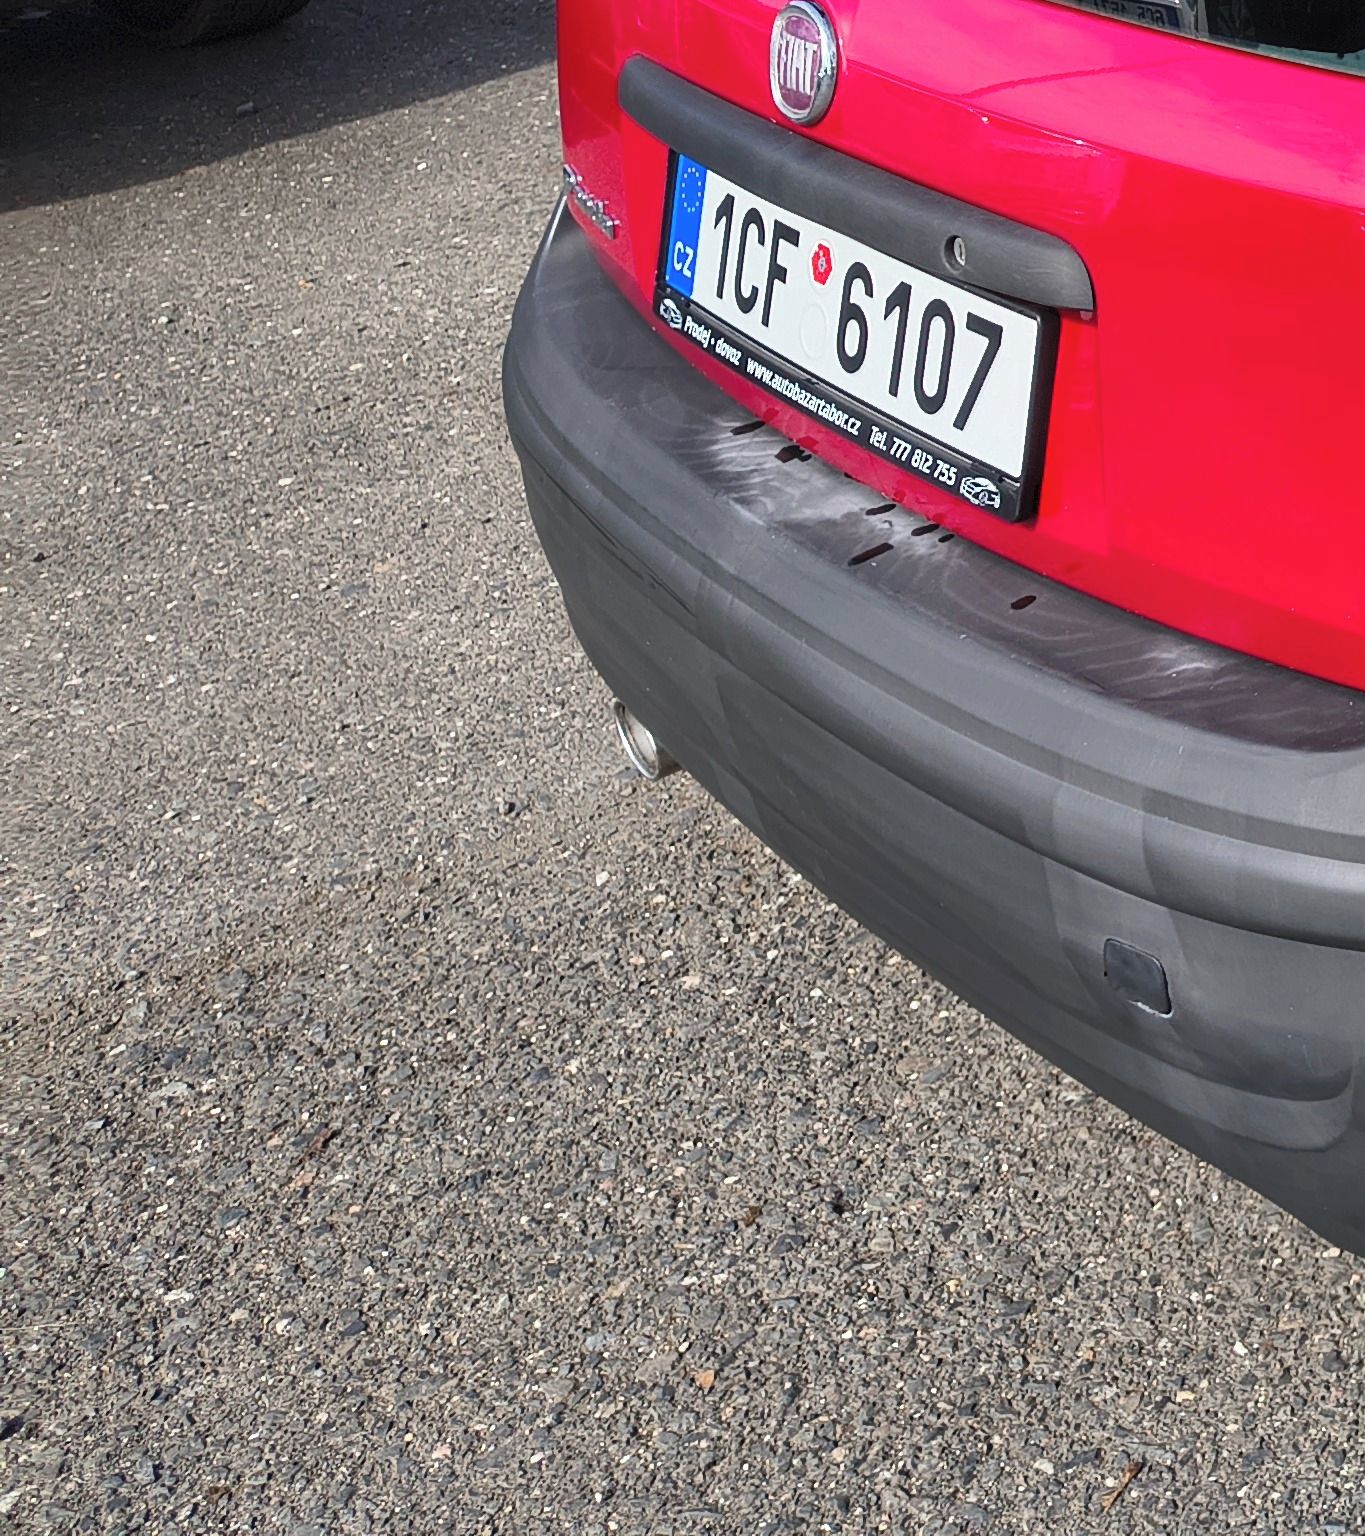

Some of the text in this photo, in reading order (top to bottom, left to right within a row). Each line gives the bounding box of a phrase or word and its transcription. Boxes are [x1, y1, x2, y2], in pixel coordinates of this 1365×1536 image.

[780, 30, 818, 96] FIAT
[673, 240, 693, 278] CZ
[713, 192, 800, 328] 1CF
[836, 261, 1004, 431] 6107
[684, 315, 958, 486] Prodej dovoz www.autobazartabor.cz Tel. 777 812 755
